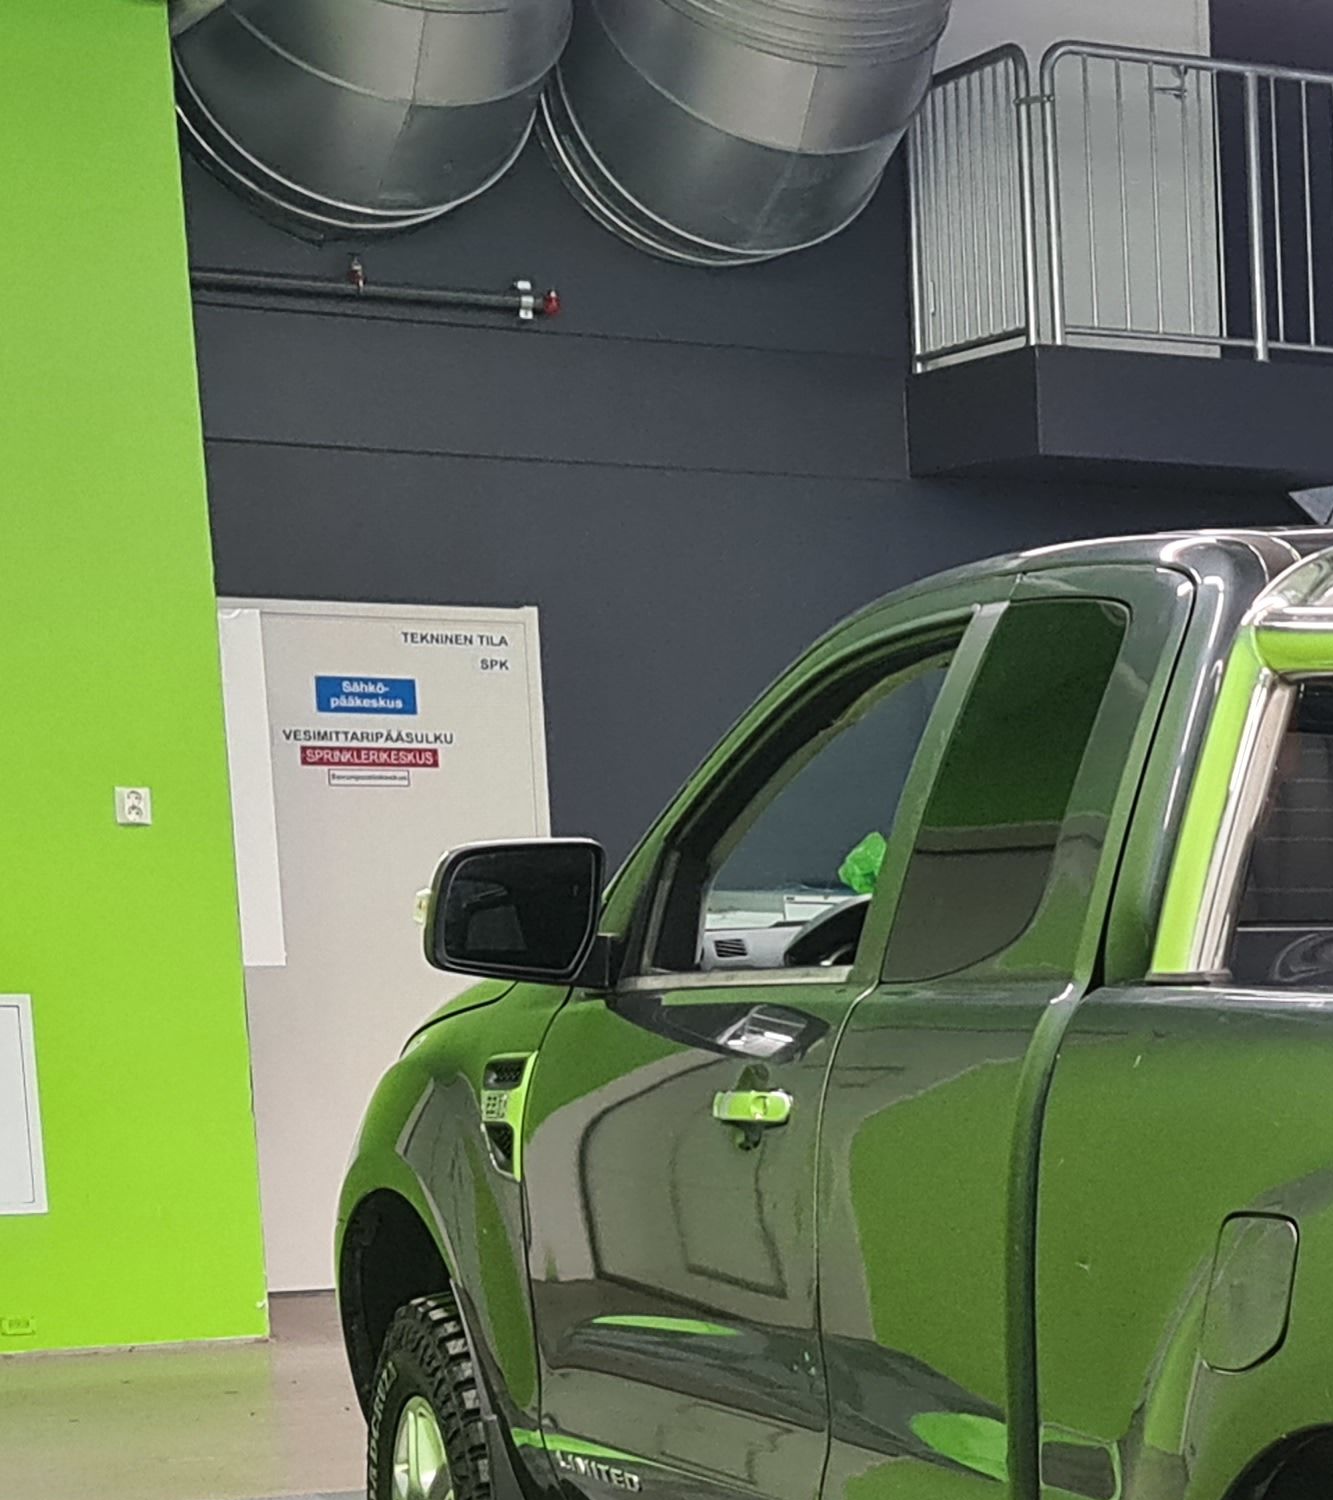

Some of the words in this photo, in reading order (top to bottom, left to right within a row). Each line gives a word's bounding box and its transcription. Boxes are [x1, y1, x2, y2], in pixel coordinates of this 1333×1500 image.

[401, 632, 473, 646] TEKNINEN
[477, 634, 508, 647] TILA
[480, 658, 509, 670] SPK
[330, 696, 403, 709] pääkeskus
[282, 729, 454, 745] VESIMITTARIPÄÄSULKU
[305, 749, 434, 764] SPRINKLERIKESKUS
[555, 1449, 641, 1493] LIMITED
